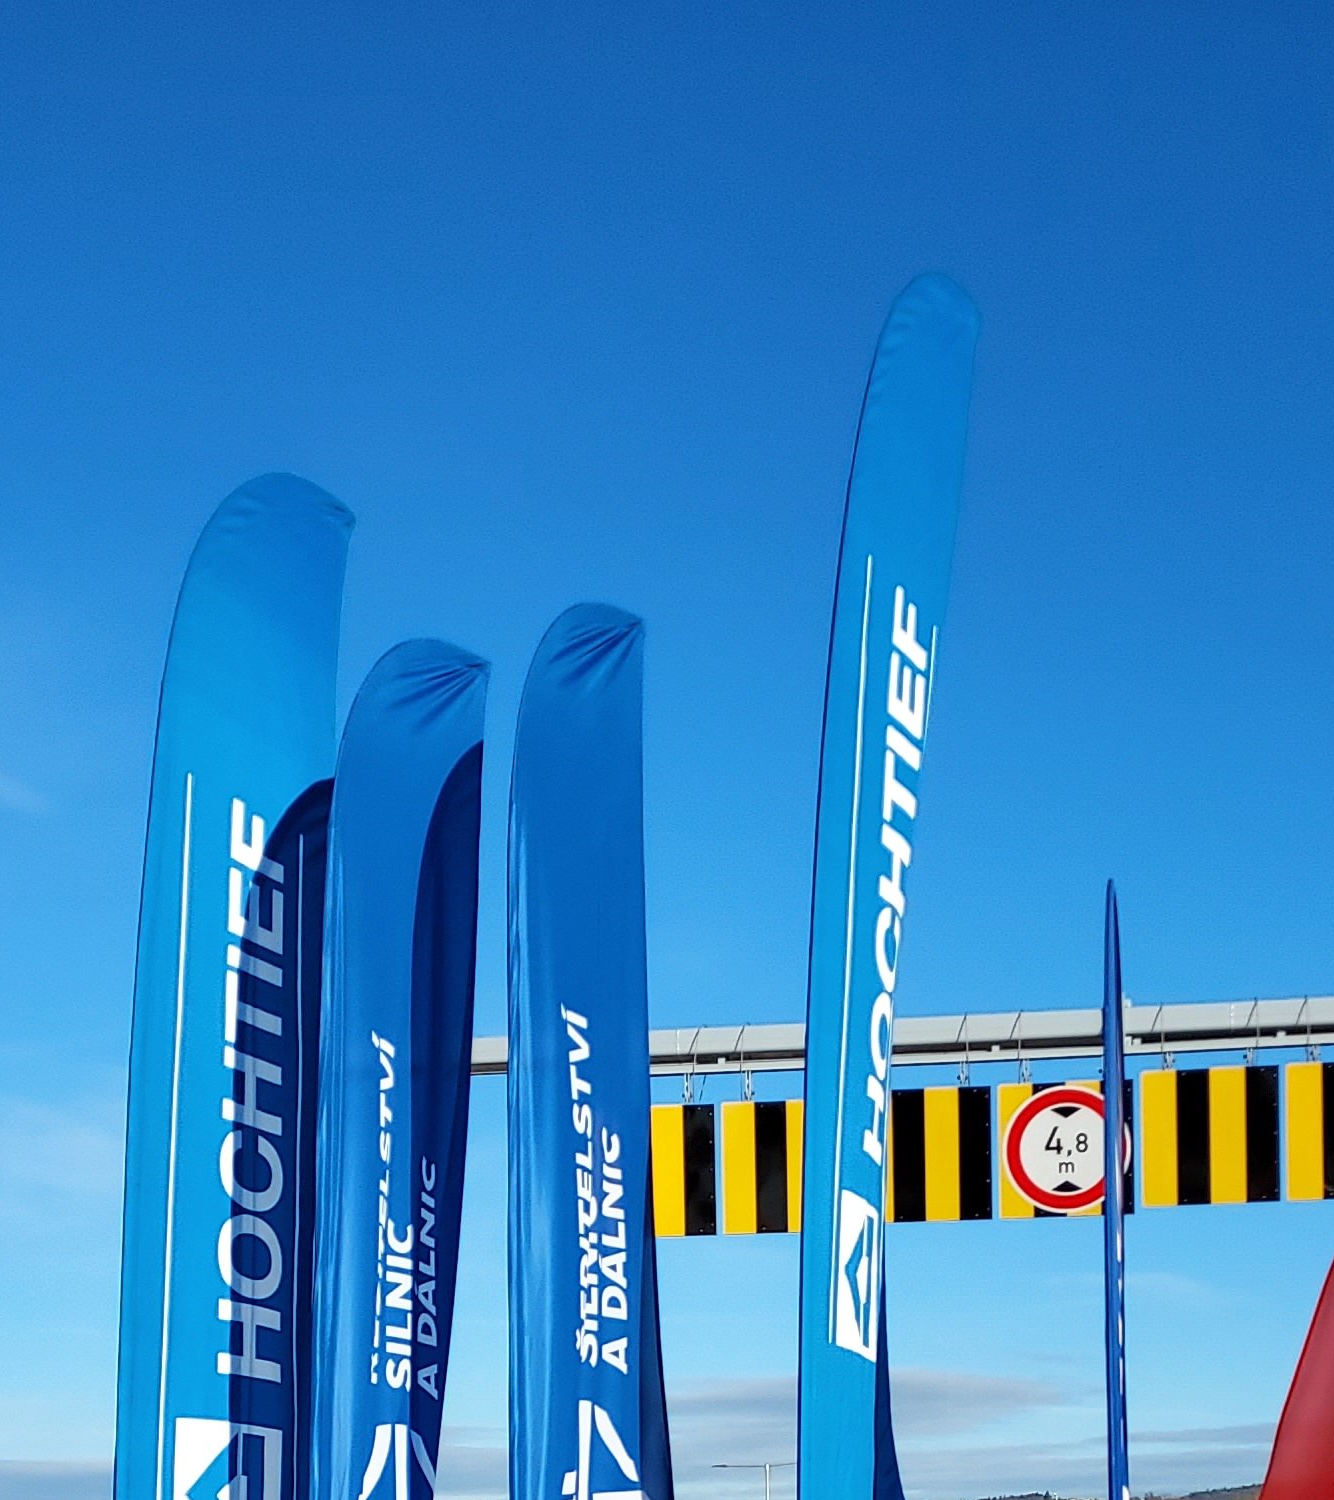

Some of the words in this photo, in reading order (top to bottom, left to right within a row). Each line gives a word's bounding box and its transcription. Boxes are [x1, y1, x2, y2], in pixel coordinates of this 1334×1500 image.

[863, 585, 930, 1167] HOCHTIEF
[217, 797, 285, 1383] HOCHTIEF
[1044, 1126, 1089, 1157] 4,8
[1058, 1162, 1075, 1174] m
[385, 1218, 414, 1392] SILNIC
[414, 1156, 438, 1349] DÁLNIC
[599, 1126, 629, 1322] DÁLNIC
[417, 1363, 439, 1400] A
[602, 1337, 629, 1375] A
